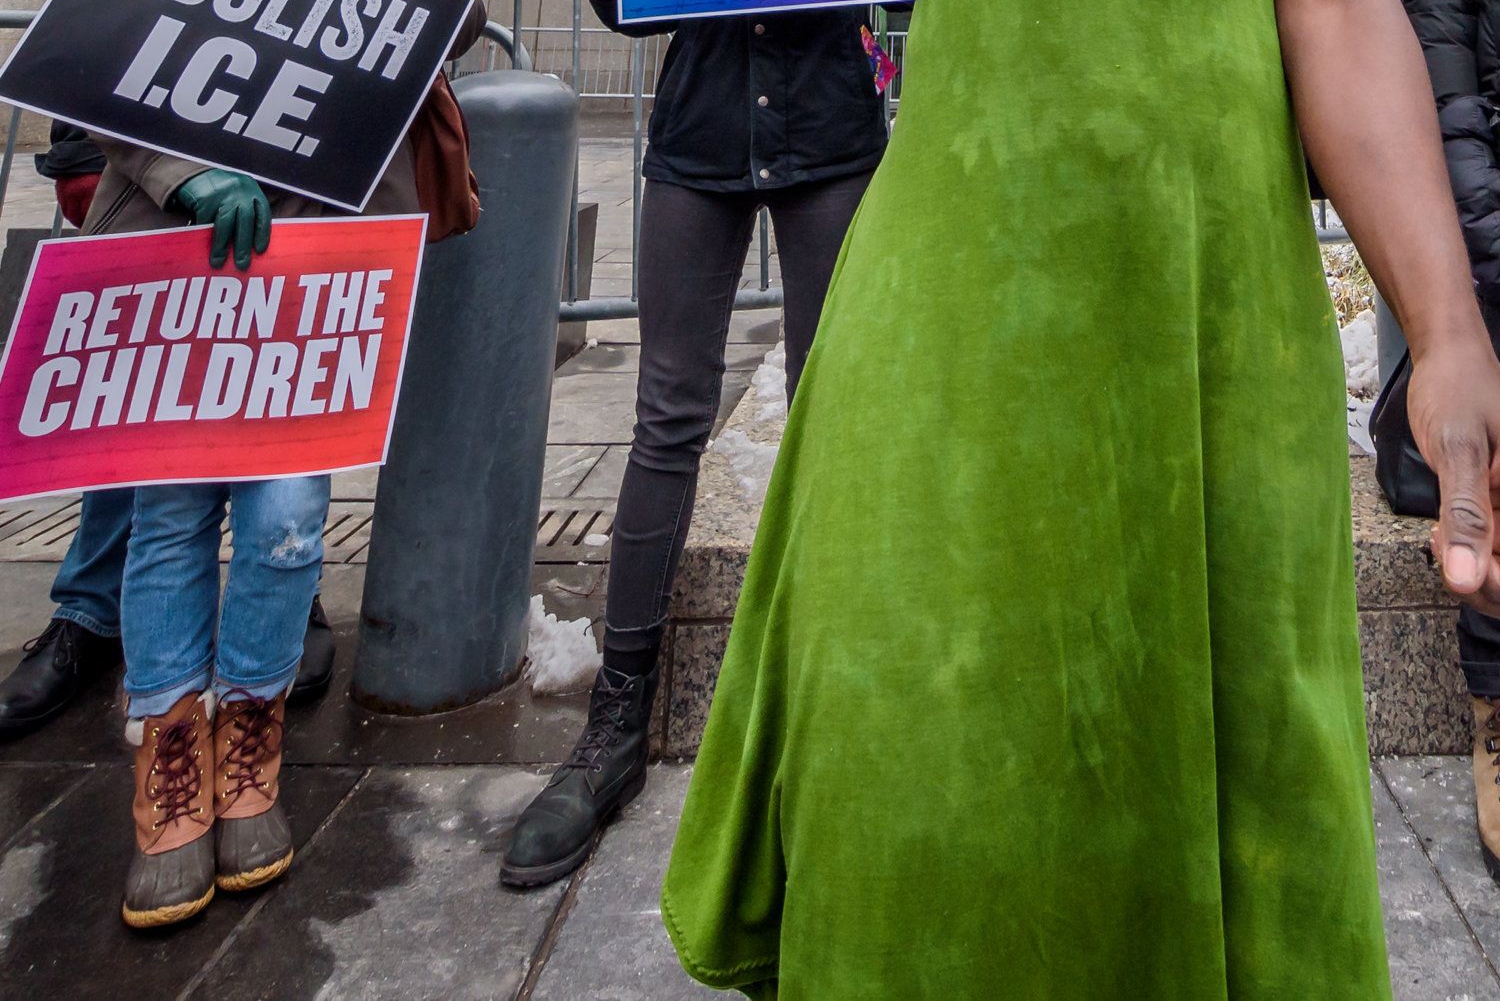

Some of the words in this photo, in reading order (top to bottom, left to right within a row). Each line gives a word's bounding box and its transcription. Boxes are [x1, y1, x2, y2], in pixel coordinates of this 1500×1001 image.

[114, 15, 336, 158] I.C.E.
[43, 275, 286, 356] RETURN
[297, 268, 394, 338] THE
[18, 333, 382, 438] CHILDREN
